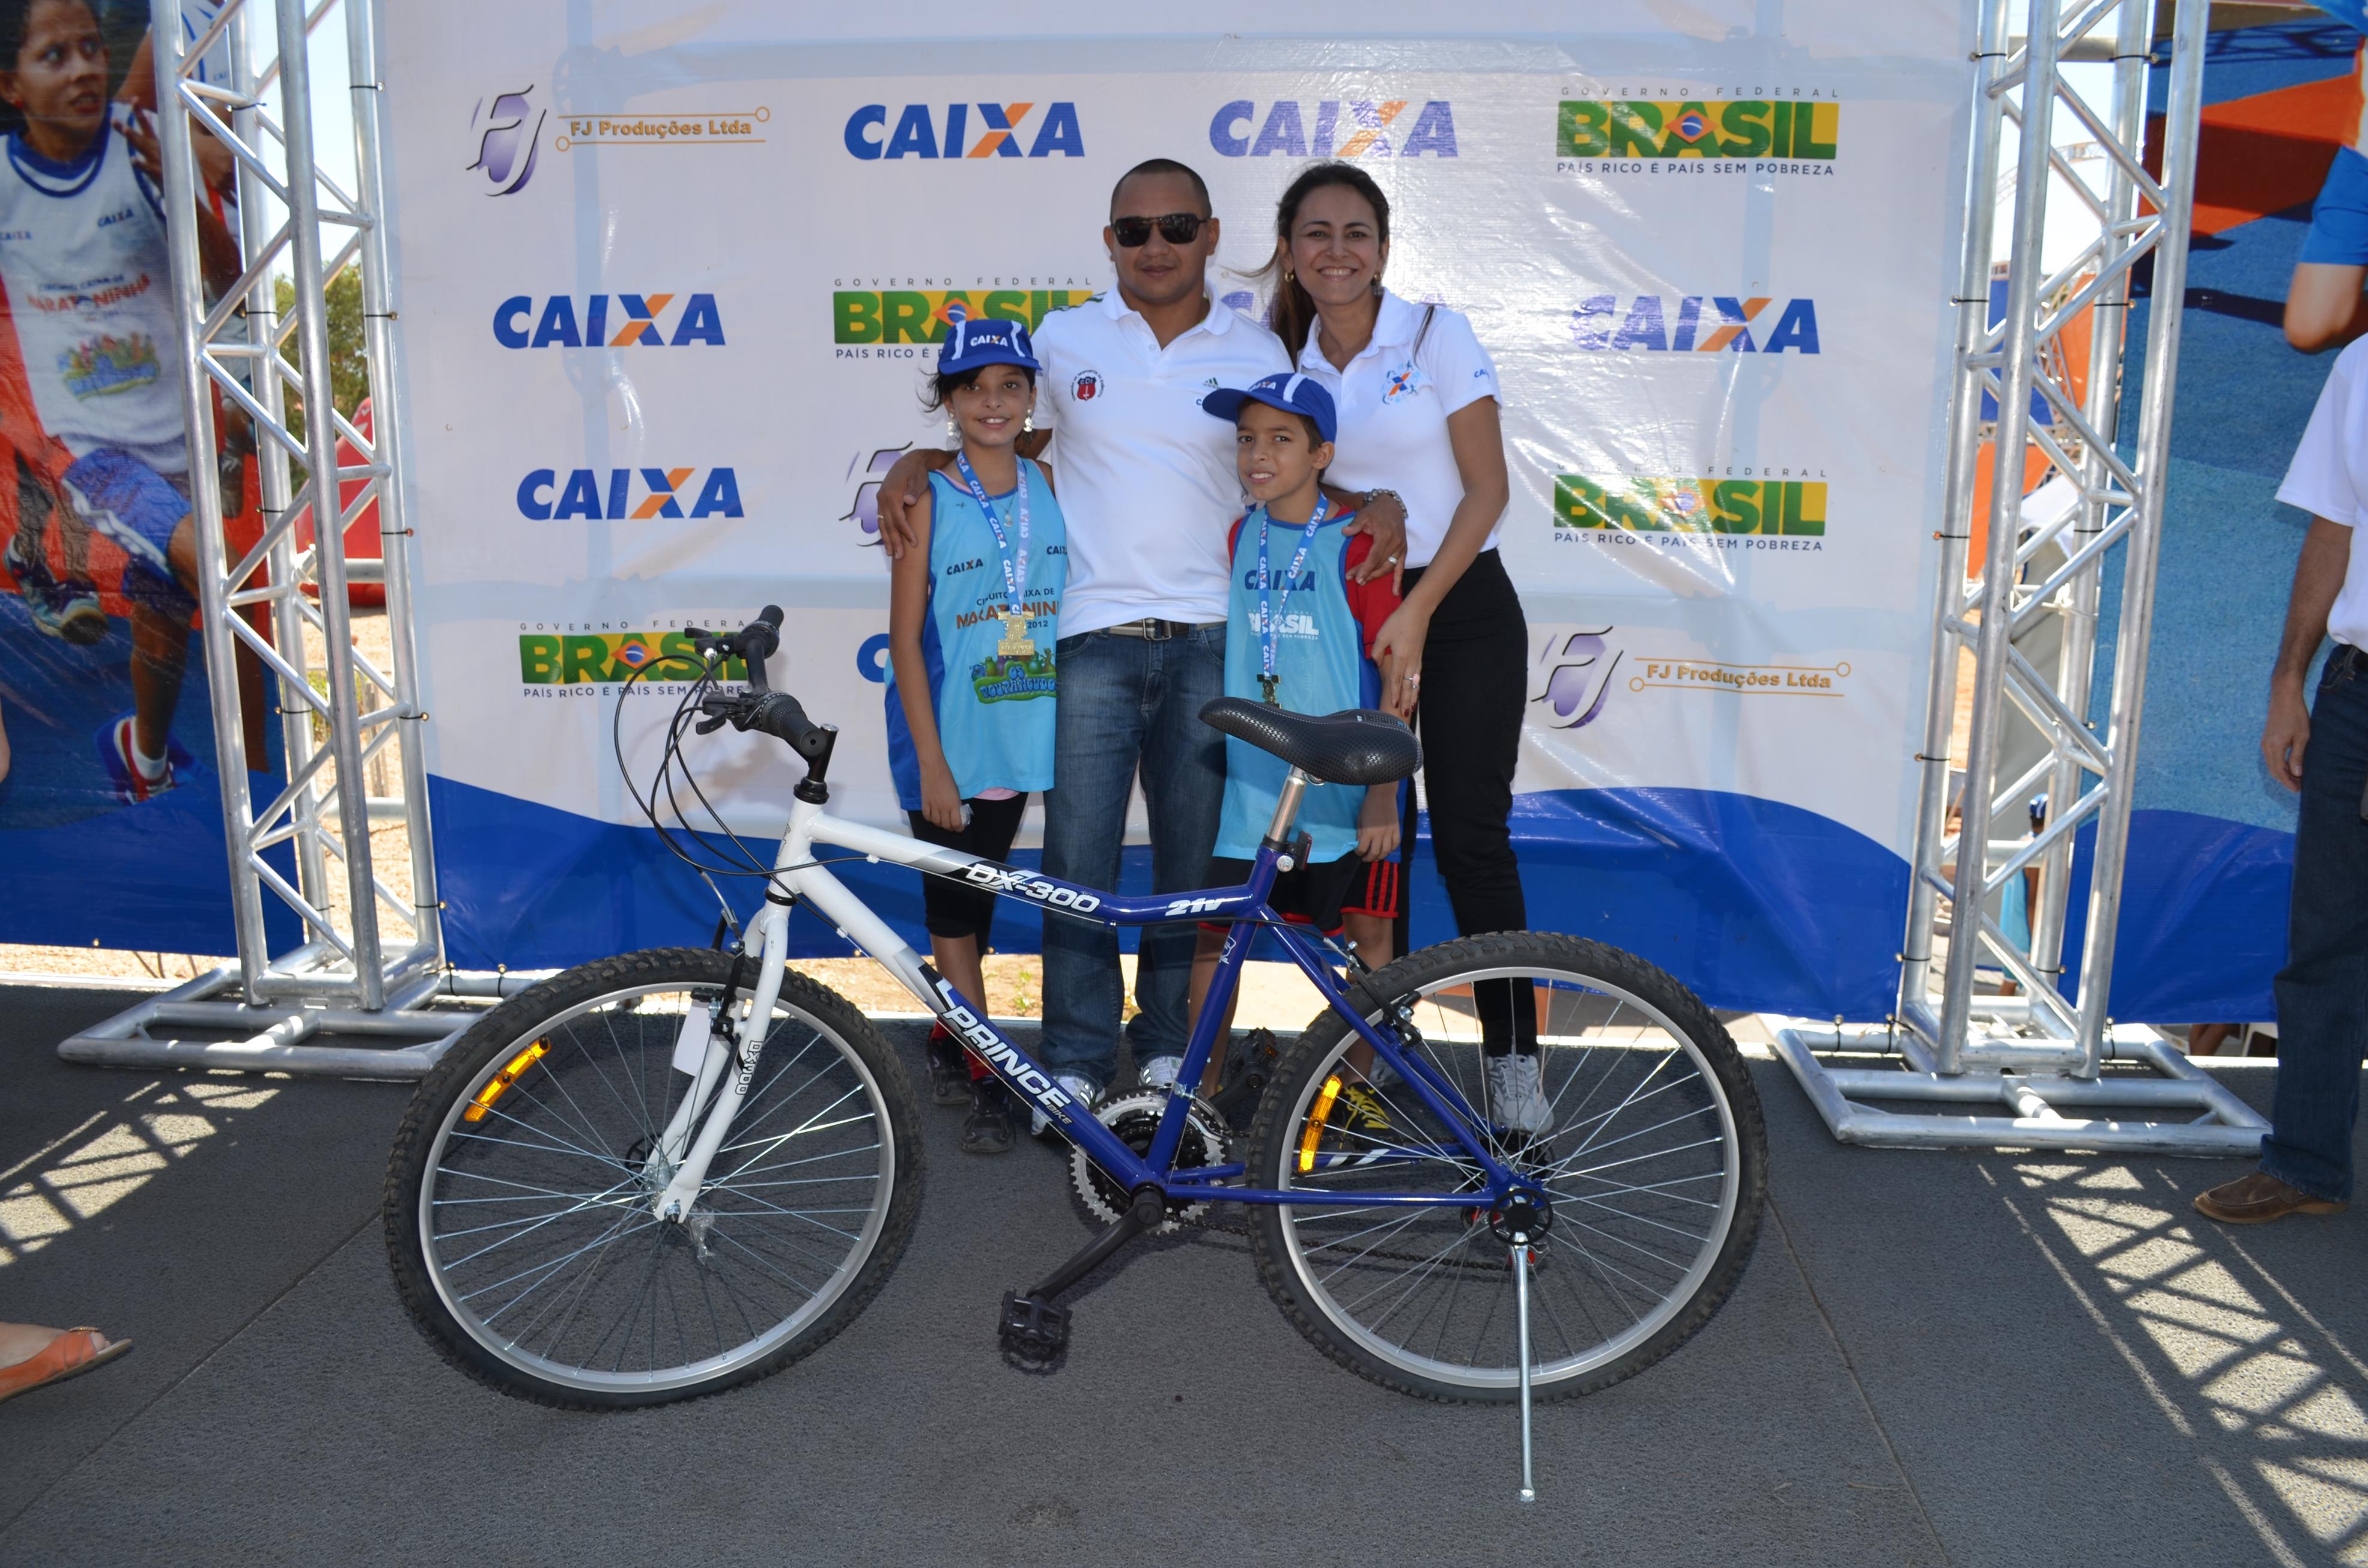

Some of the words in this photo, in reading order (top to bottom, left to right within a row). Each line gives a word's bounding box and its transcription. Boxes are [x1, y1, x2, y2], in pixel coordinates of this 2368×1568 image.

[1562, 87, 1689, 97] GOVERNO
[1716, 87, 1839, 97] FEDERAL
[570, 122, 593, 136] FJ
[599, 121, 703, 139] Produções
[709, 120, 752, 136] Ltda
[843, 101, 1085, 160] CAIXA
[1209, 99, 1459, 158] CAIXA
[1556, 100, 1839, 159] BRASIL
[1557, 161, 1593, 174] PAÍS
[1601, 162, 1642, 174] RICO
[1651, 161, 1659, 174] É
[1668, 161, 1705, 174] PAÍS
[1713, 163, 1747, 174] SEM
[1756, 163, 1834, 176] POBREZA
[834, 277, 952, 287] GOVERNO
[977, 277, 1091, 286] FEDERAL
[493, 293, 726, 350] CAIXA
[1571, 294, 1820, 354] CAIXA
[970, 334, 1009, 347] CAIXA
[836, 347, 869, 359] PAÍS
[877, 348, 914, 359] RICO
[922, 347, 931, 359] É
[1708, 466, 1827, 478] FEDERAL
[517, 467, 745, 521] CAIXA
[970, 480, 990, 509] CAIXA
[989, 517, 1007, 549] CAIXA
[1598, 534, 1636, 546] RICO
[1707, 538, 1738, 549] SEM
[1746, 539, 1823, 552] POBREZA
[947, 558, 984, 575] CAIXA
[1003, 559, 1016, 593] CAIXA
[520, 621, 628, 631] GOVERNO
[1027, 620, 1048, 629] 2012
[1647, 664, 1671, 679] FJ
[1677, 665, 1781, 689] Produções
[1787, 673, 1832, 688] Ltda
[524, 687, 552, 698] PAÍS
[559, 688, 595, 698] RICO
[603, 686, 610, 695] É
[658, 686, 687, 695] SEM
[965, 863, 1101, 913] DX-300
[942, 1005, 1072, 1108] PRINCE
[1046, 1104, 1072, 1125] BIKE
